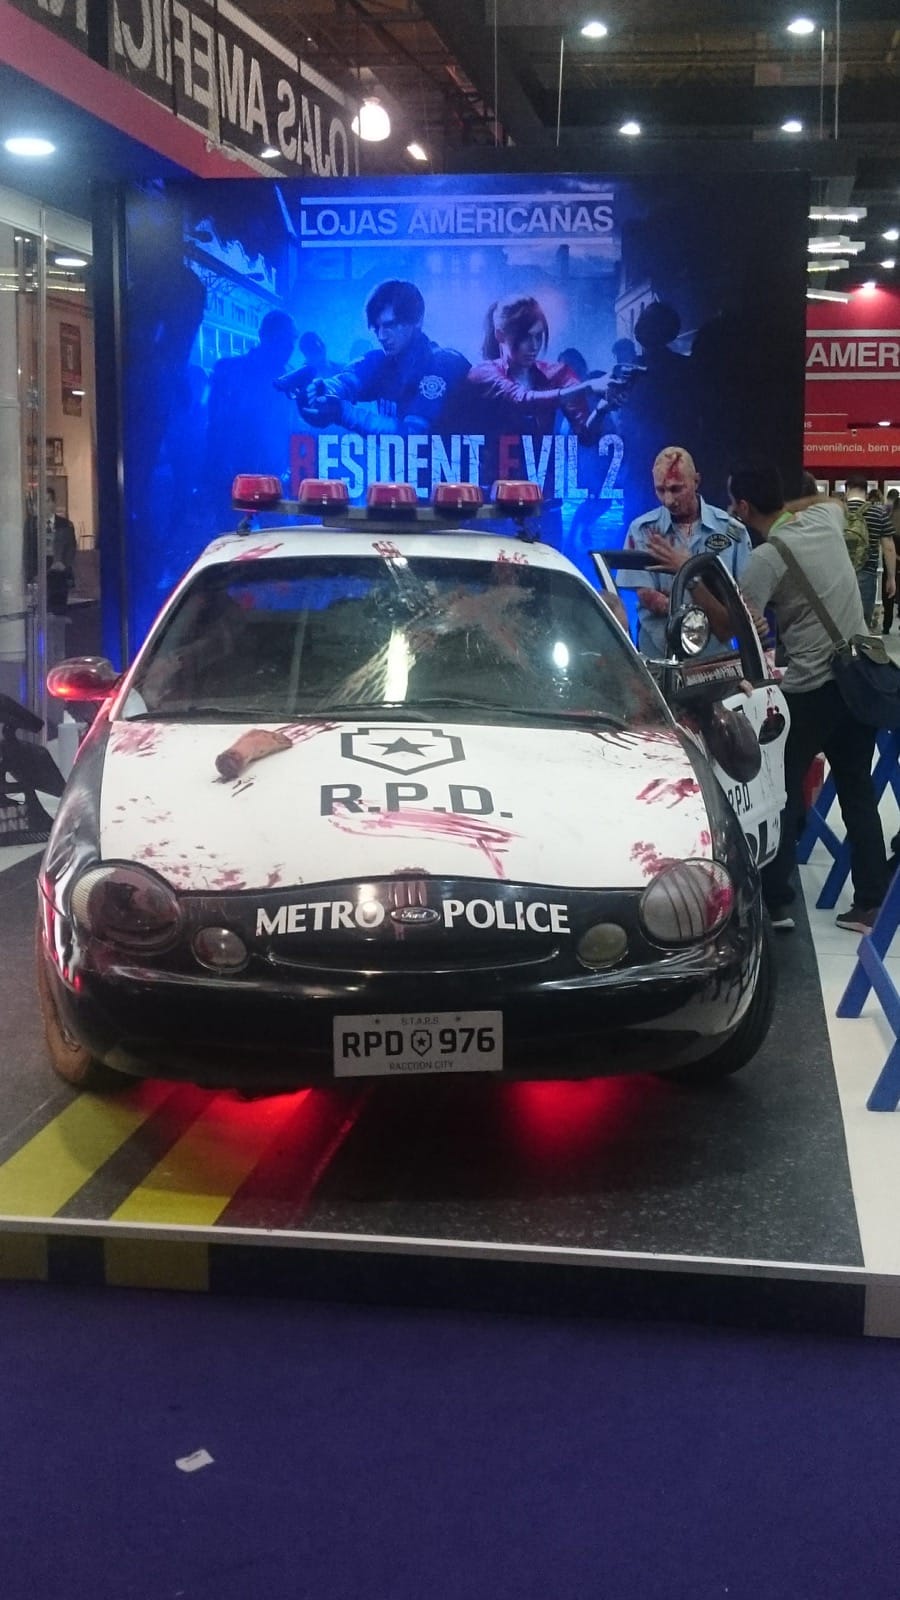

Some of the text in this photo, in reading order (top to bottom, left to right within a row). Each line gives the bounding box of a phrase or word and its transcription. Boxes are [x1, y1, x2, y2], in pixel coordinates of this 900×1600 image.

[300, 205, 614, 236] LOJAS AMERICANAS
[289, 433, 486, 498] RESIDENT
[320, 782, 513, 818] R.P.D.
[255, 899, 571, 936] METRO POLICE
[342, 1027, 496, 1058] RPD 976
[434, 1060, 454, 1069] CITY
